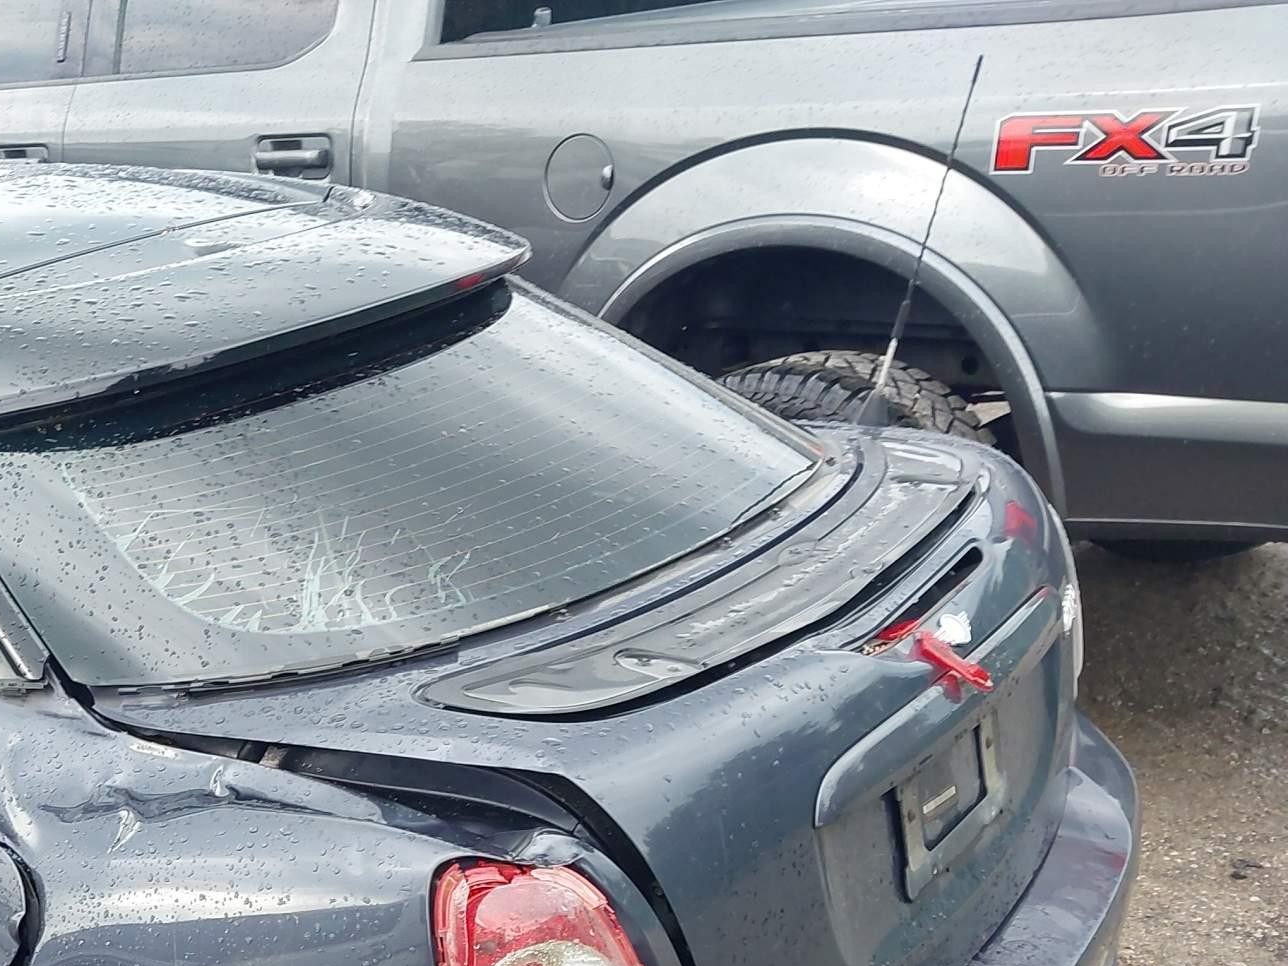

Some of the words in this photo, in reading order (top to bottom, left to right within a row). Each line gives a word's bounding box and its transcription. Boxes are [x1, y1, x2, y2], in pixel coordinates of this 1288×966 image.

[991, 104, 1261, 174] FX4
[1099, 162, 1158, 177] OFF
[1165, 162, 1250, 177] ROAD
